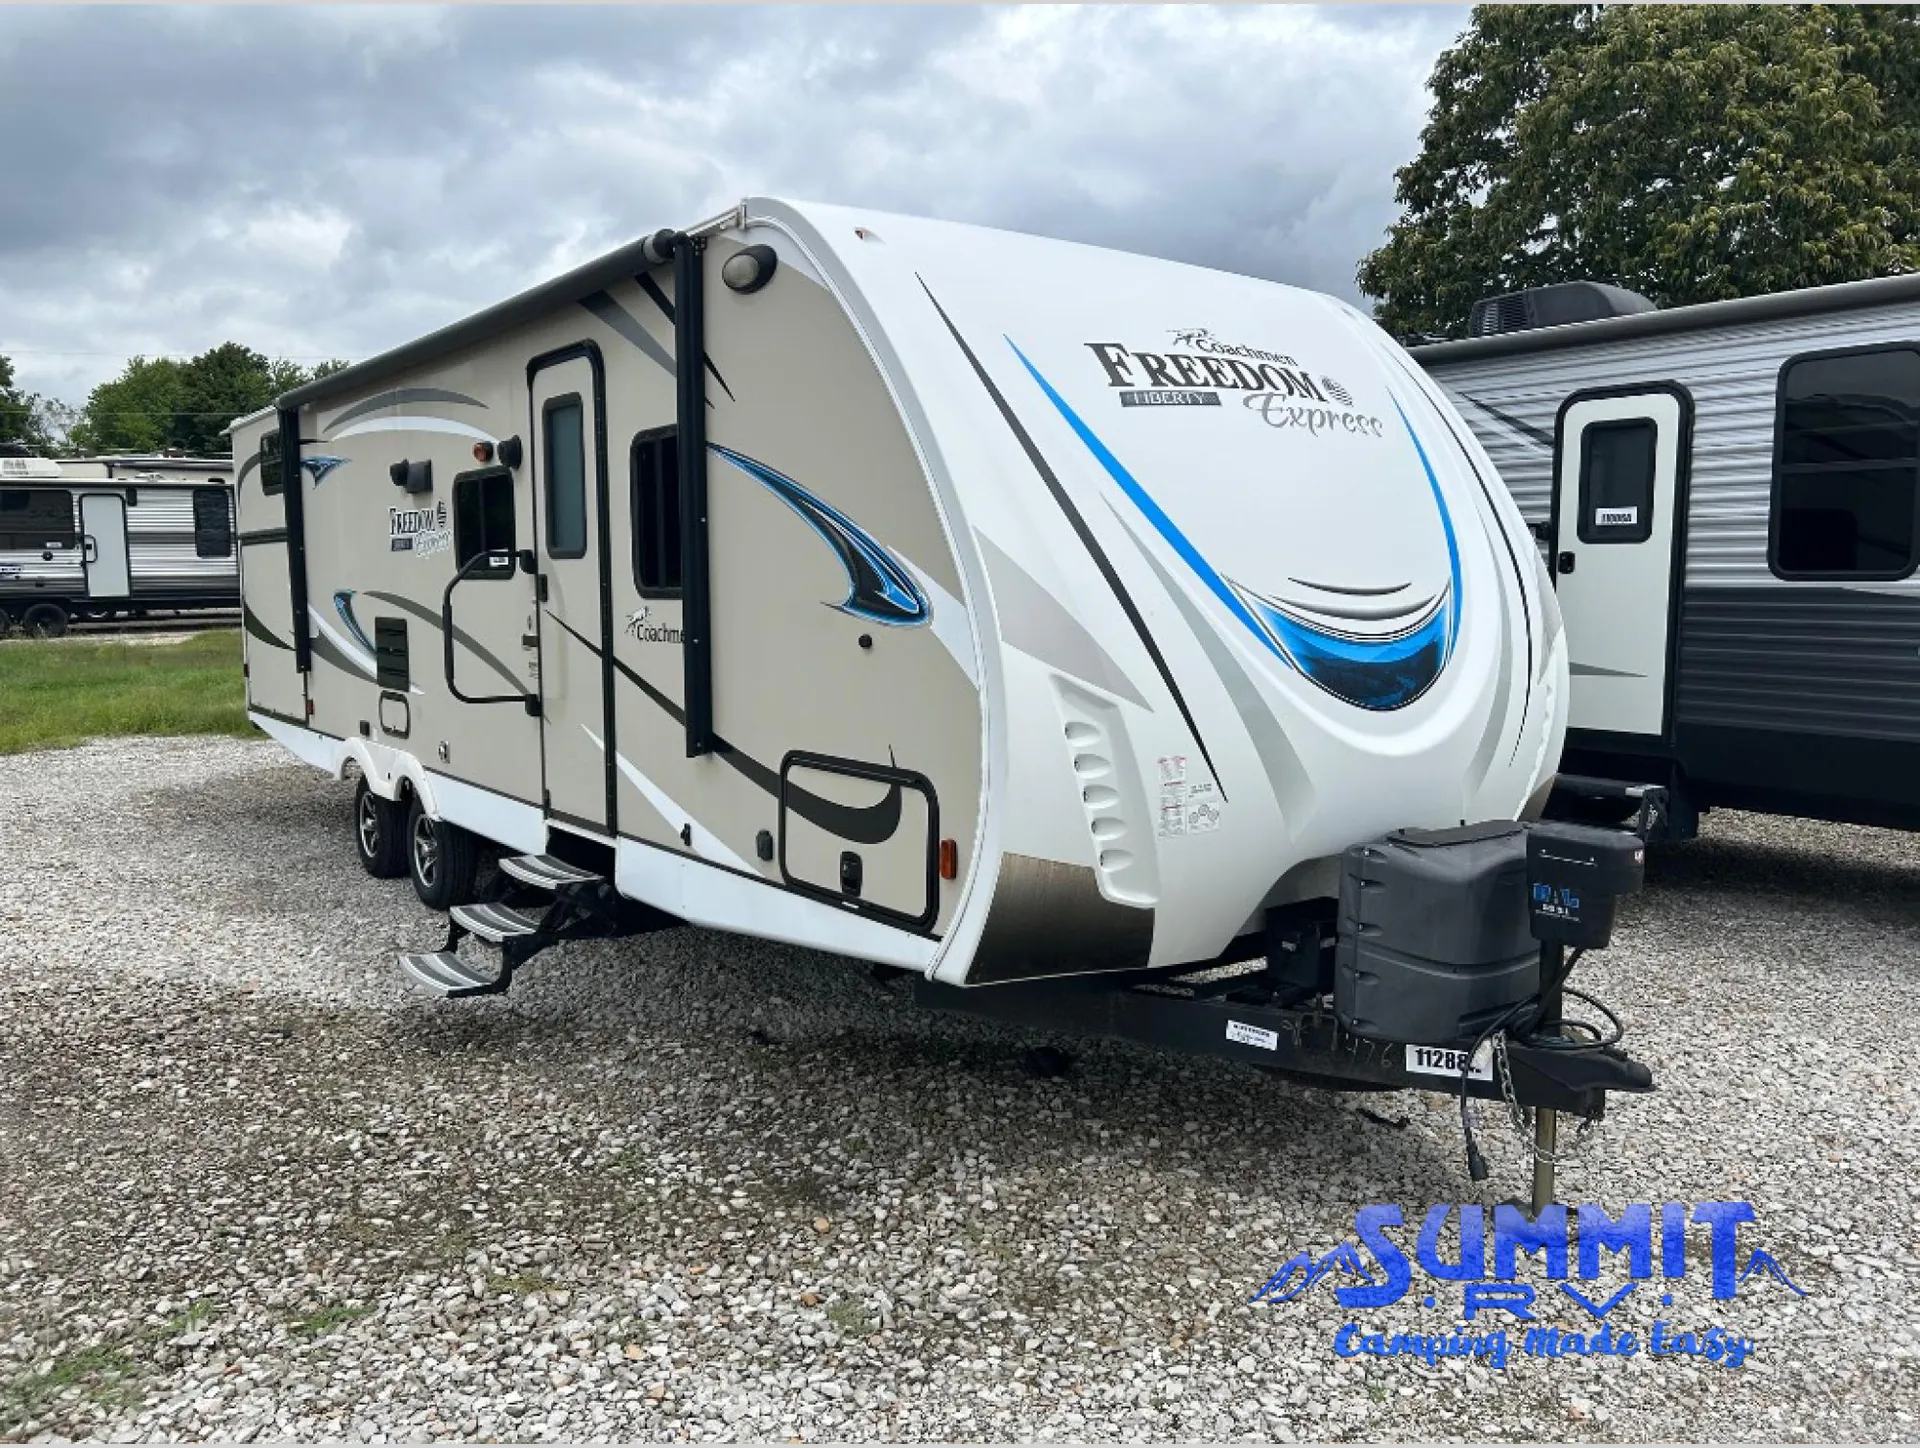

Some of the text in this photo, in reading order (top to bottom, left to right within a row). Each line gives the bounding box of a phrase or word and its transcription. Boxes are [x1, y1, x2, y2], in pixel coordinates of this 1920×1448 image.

[1195, 339, 1298, 367] Coachmen
[1084, 343, 1330, 404] FREEDOM
[1133, 391, 1205, 404] LIBERTY
[1242, 392, 1383, 437] Express
[1415, 1048, 1482, 1074] 11288
